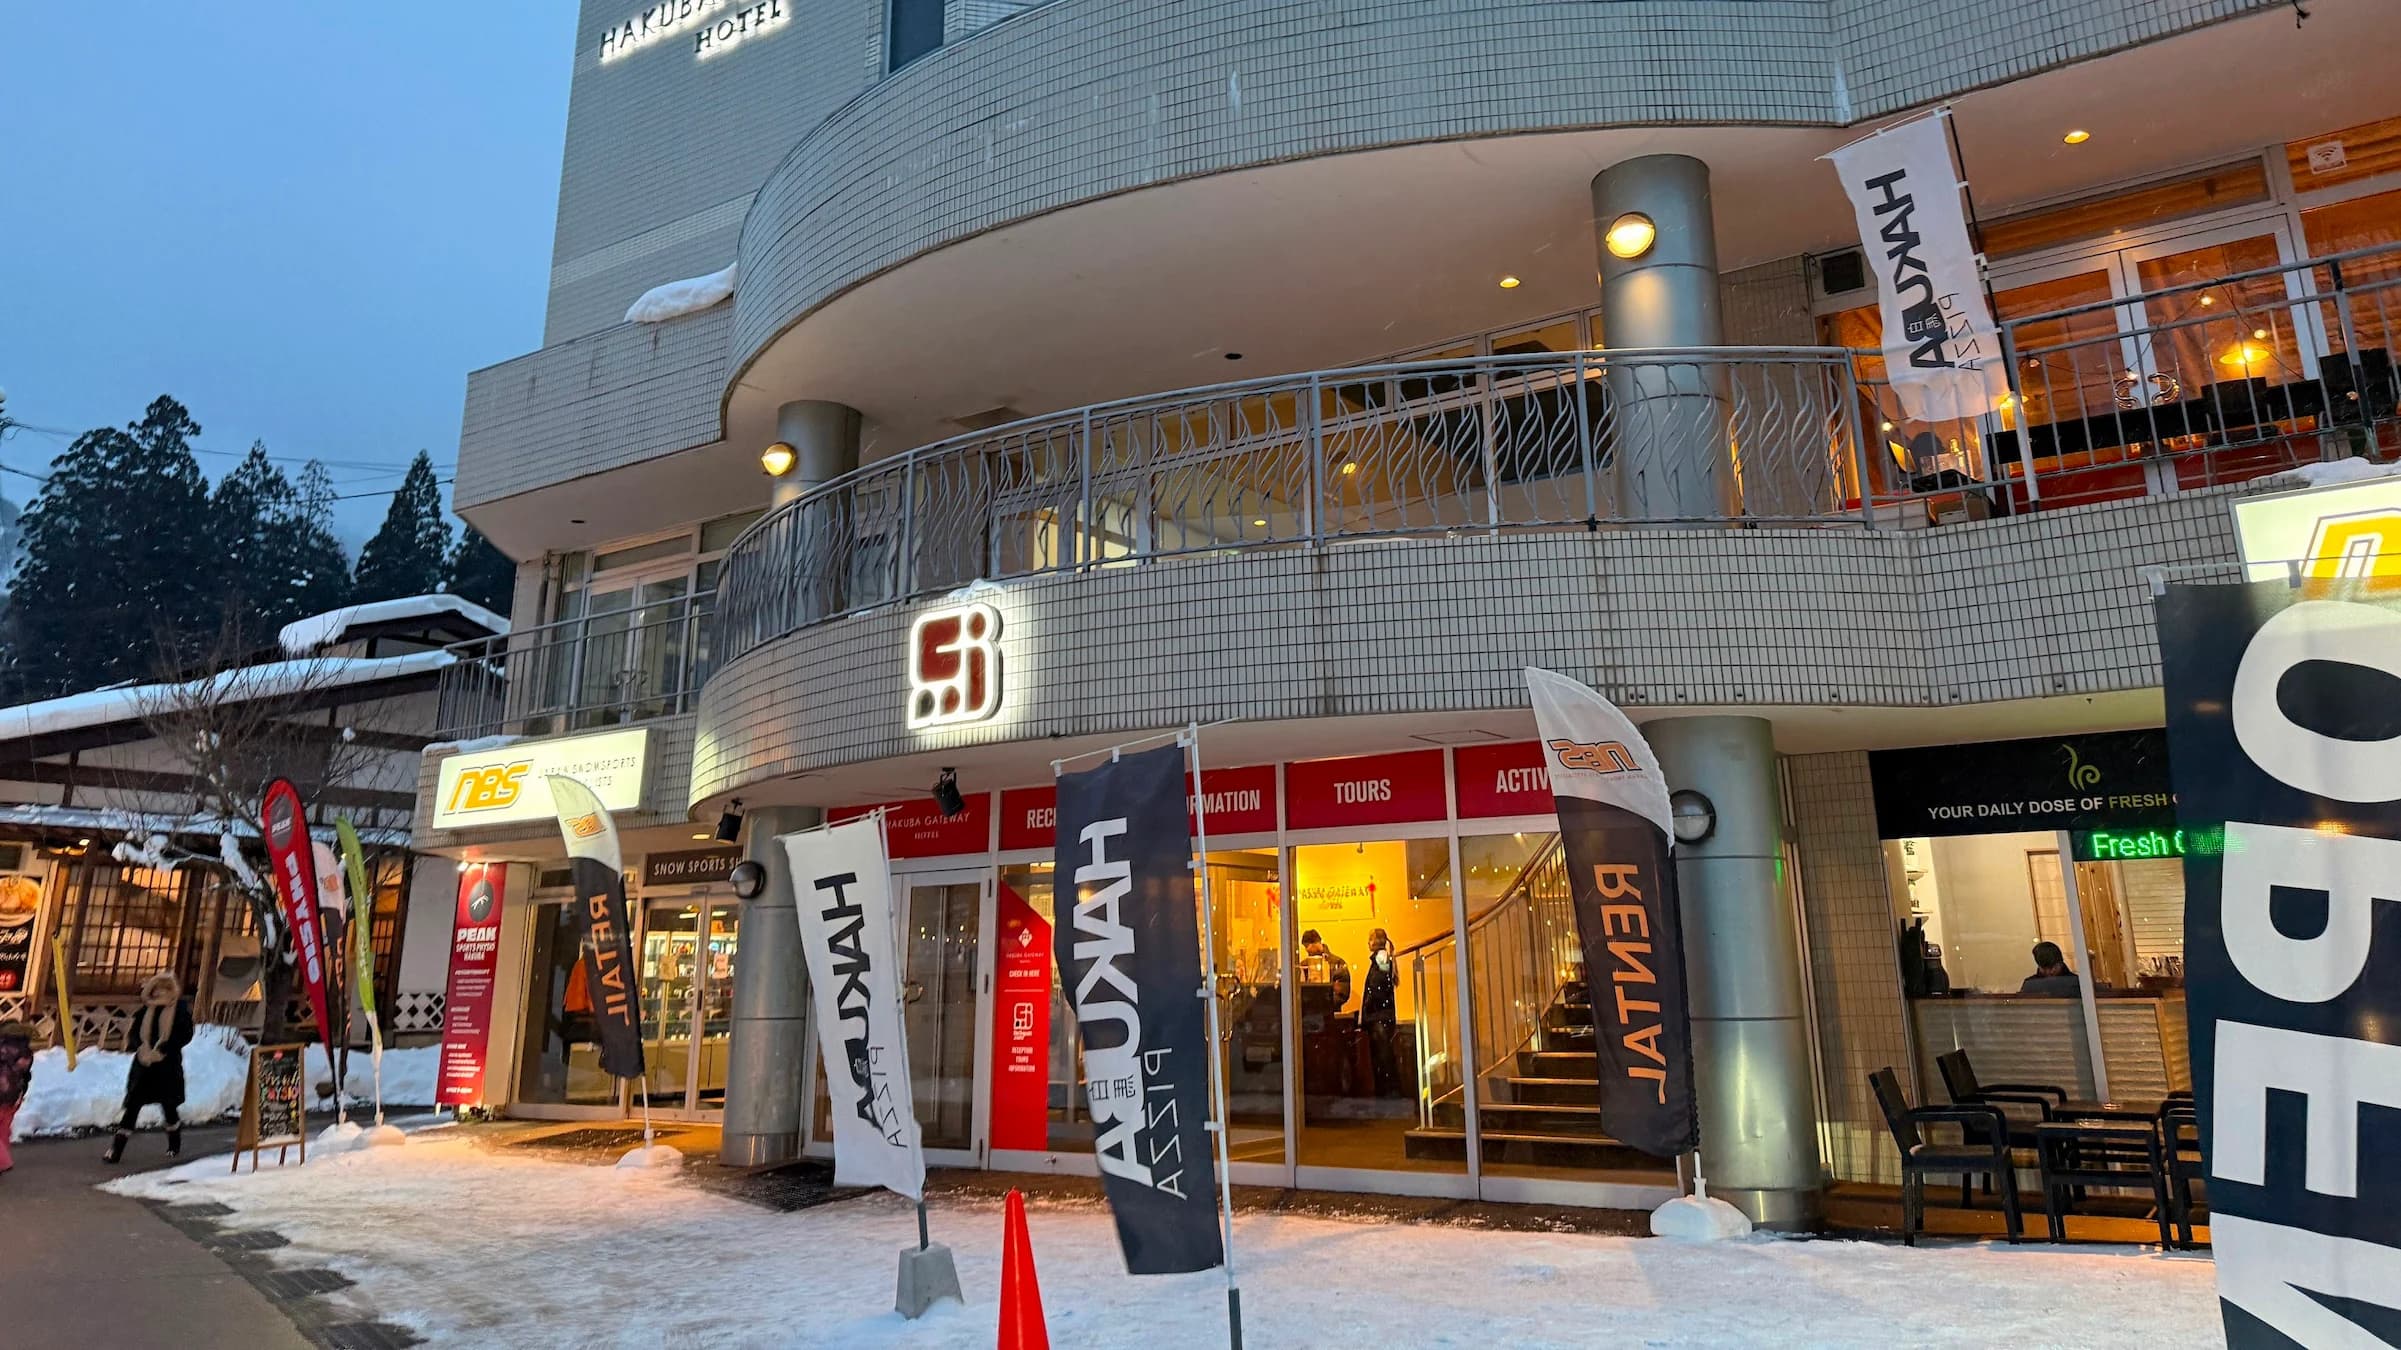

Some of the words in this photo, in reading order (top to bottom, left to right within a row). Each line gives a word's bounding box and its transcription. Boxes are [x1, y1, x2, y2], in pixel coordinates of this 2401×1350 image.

[694, 0, 782, 53] HOTEL
[443, 759, 534, 816] NBS
[1333, 778, 1391, 804] TOURS
[924, 812, 971, 827] GATEWAY
[1928, 806, 1974, 820] YOUR
[1978, 802, 2024, 817] DAILY
[2029, 799, 2076, 814] DOSE
[2080, 797, 2103, 811] OF
[2108, 793, 2168, 809] FRESH
[2092, 831, 2170, 858] Fresh
[653, 861, 685, 876] SNOW
[688, 858, 726, 874] SPORTS
[285, 851, 320, 984] PHYSIO
